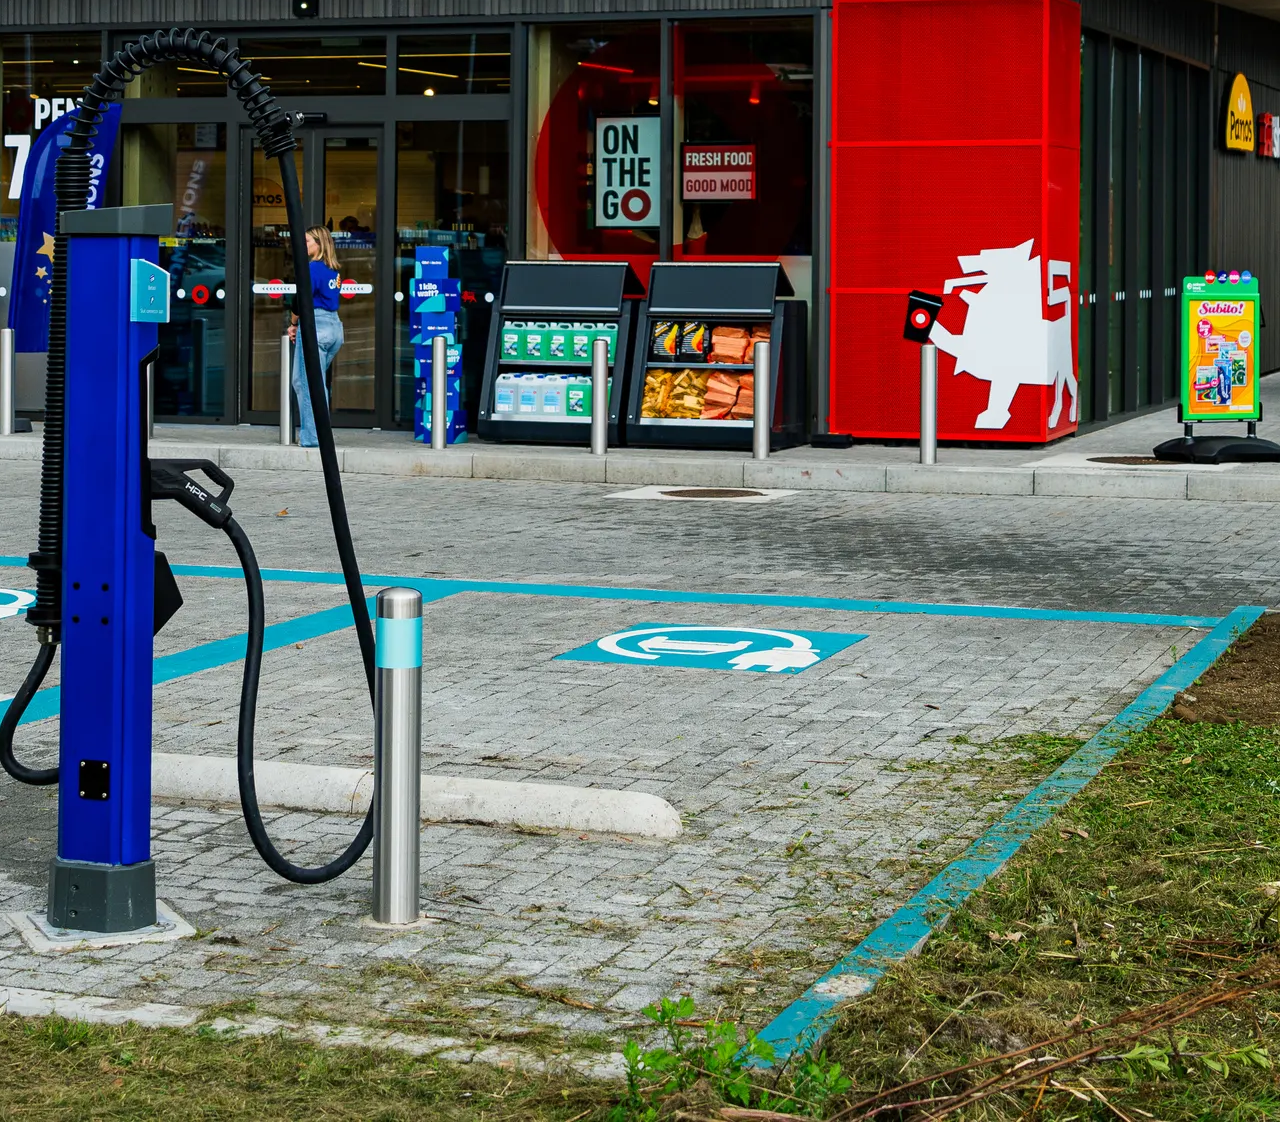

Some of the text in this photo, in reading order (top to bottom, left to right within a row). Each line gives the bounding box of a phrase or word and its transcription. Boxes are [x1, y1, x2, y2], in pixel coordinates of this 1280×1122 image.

[1230, 110, 1252, 142] Panos
[603, 124, 639, 155] ON
[685, 151, 753, 166] FRESH FOOD
[602, 157, 651, 187] THE
[686, 178, 753, 193] GOOD MOOD
[603, 188, 651, 222] GO
[1198, 301, 1245, 315] Subito!
[185, 482, 208, 501] HPC
